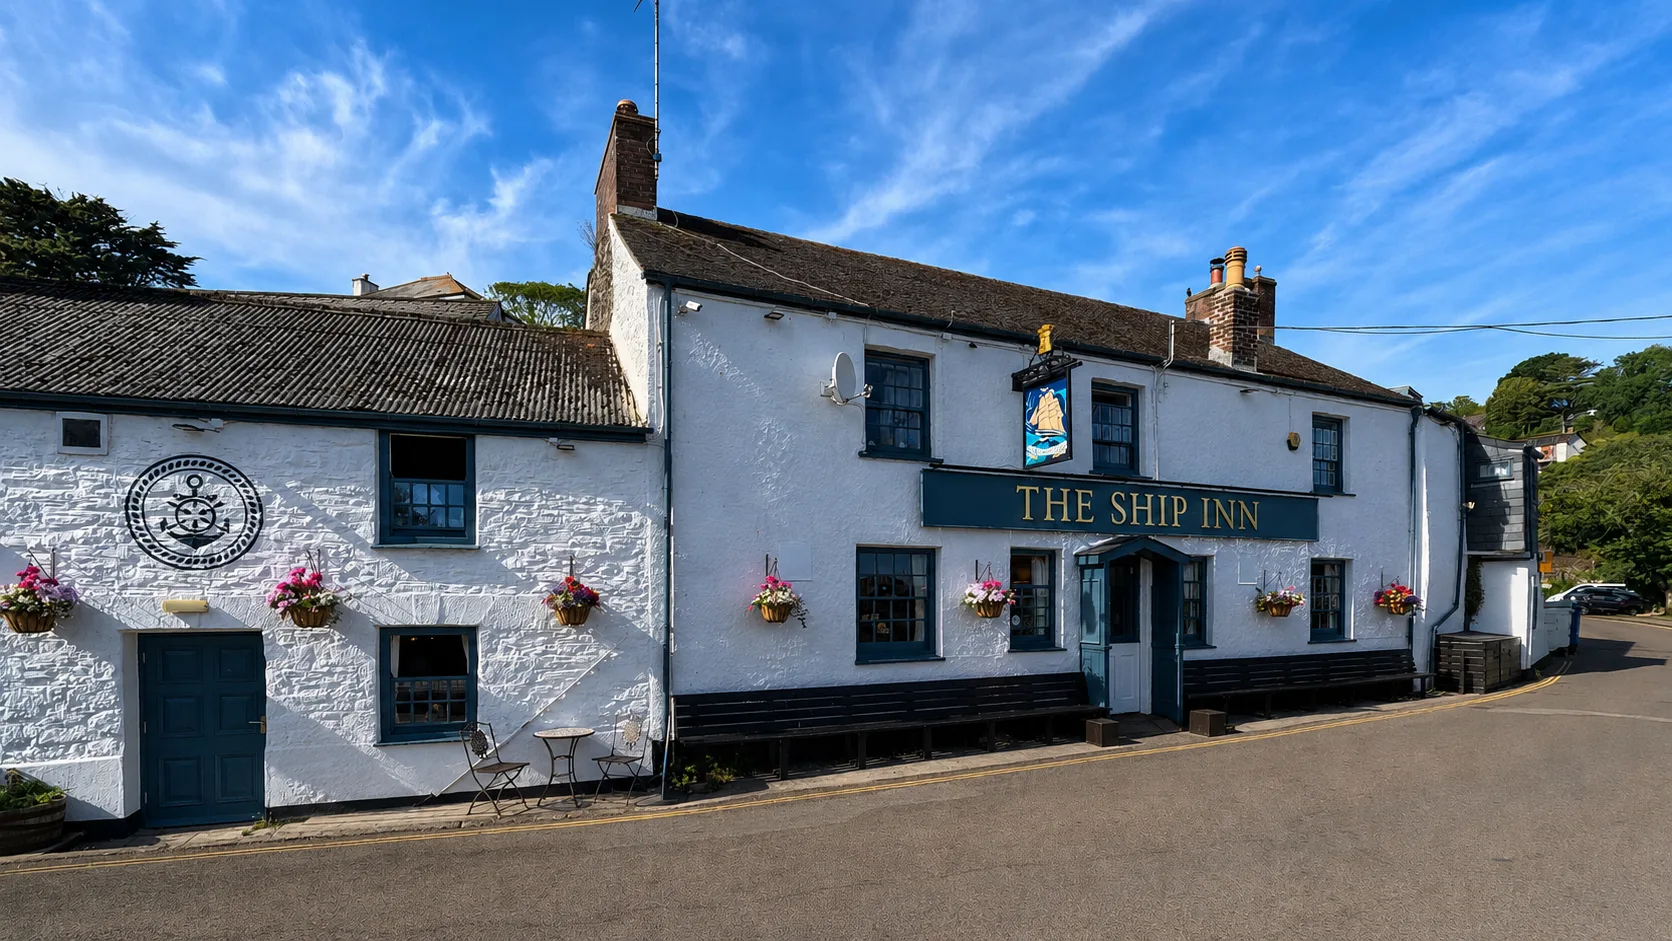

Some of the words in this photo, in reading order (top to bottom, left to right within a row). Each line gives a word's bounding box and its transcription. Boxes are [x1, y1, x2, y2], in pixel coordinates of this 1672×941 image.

[1016, 485, 1095, 523] THE
[1110, 491, 1188, 528] SHIP
[1201, 497, 1260, 531] INN
